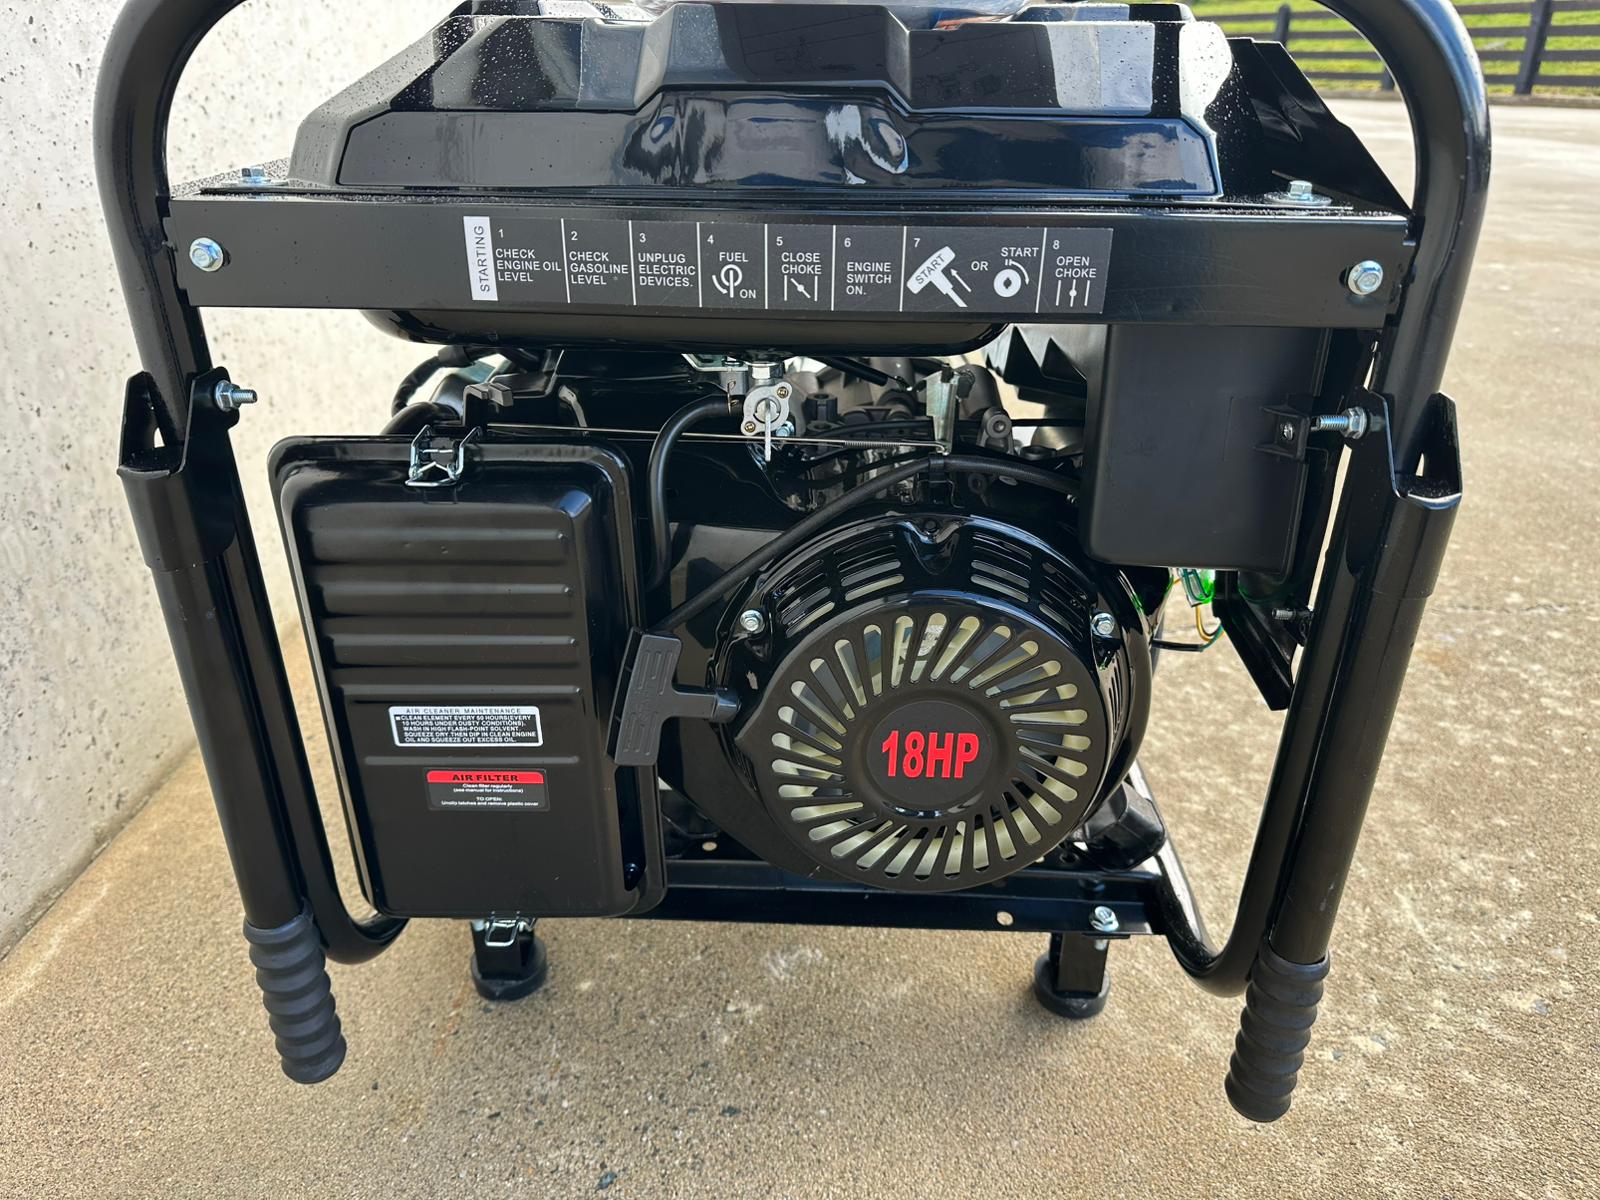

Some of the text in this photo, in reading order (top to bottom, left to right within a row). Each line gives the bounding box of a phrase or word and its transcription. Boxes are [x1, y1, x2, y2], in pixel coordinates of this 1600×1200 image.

[499, 229, 504, 238] 1
[571, 231, 578, 241] 2
[639, 233, 646, 243] 3
[707, 234, 715, 244] 4
[776, 236, 783, 246] 5
[844, 237, 851, 248] 6
[914, 237, 921, 248] 7
[1053, 239, 1060, 250] 8
[495, 249, 536, 259] CHECK
[569, 252, 610, 262] CHECK
[1001, 247, 1039, 257] START
[474, 226, 490, 292] STARTING
[638, 253, 686, 263] UNPLUG
[719, 252, 749, 263] FUEL
[781, 252, 821, 263] CLOSE
[1056, 256, 1090, 266] OPEN
[497, 260, 562, 272] ENGINE OIL
[570, 263, 629, 274] GASOLINE
[638, 265, 696, 276] ELECTRIC
[781, 264, 822, 275] CHOKE
[847, 262, 892, 272] ENGINE
[915, 253, 946, 285] START
[971, 261, 989, 271] OR
[498, 272, 534, 282] LEVEL
[1055, 268, 1097, 278] CHOKE
[571, 274, 607, 285] LEVEL
[639, 276, 694, 287] DEVICES.
[846, 273, 892, 284] SWITCH
[739, 289, 757, 299] ON
[846, 285, 867, 295] ON.
[882, 730, 979, 778] 18HP
[476, 774, 518, 782] FILTER
